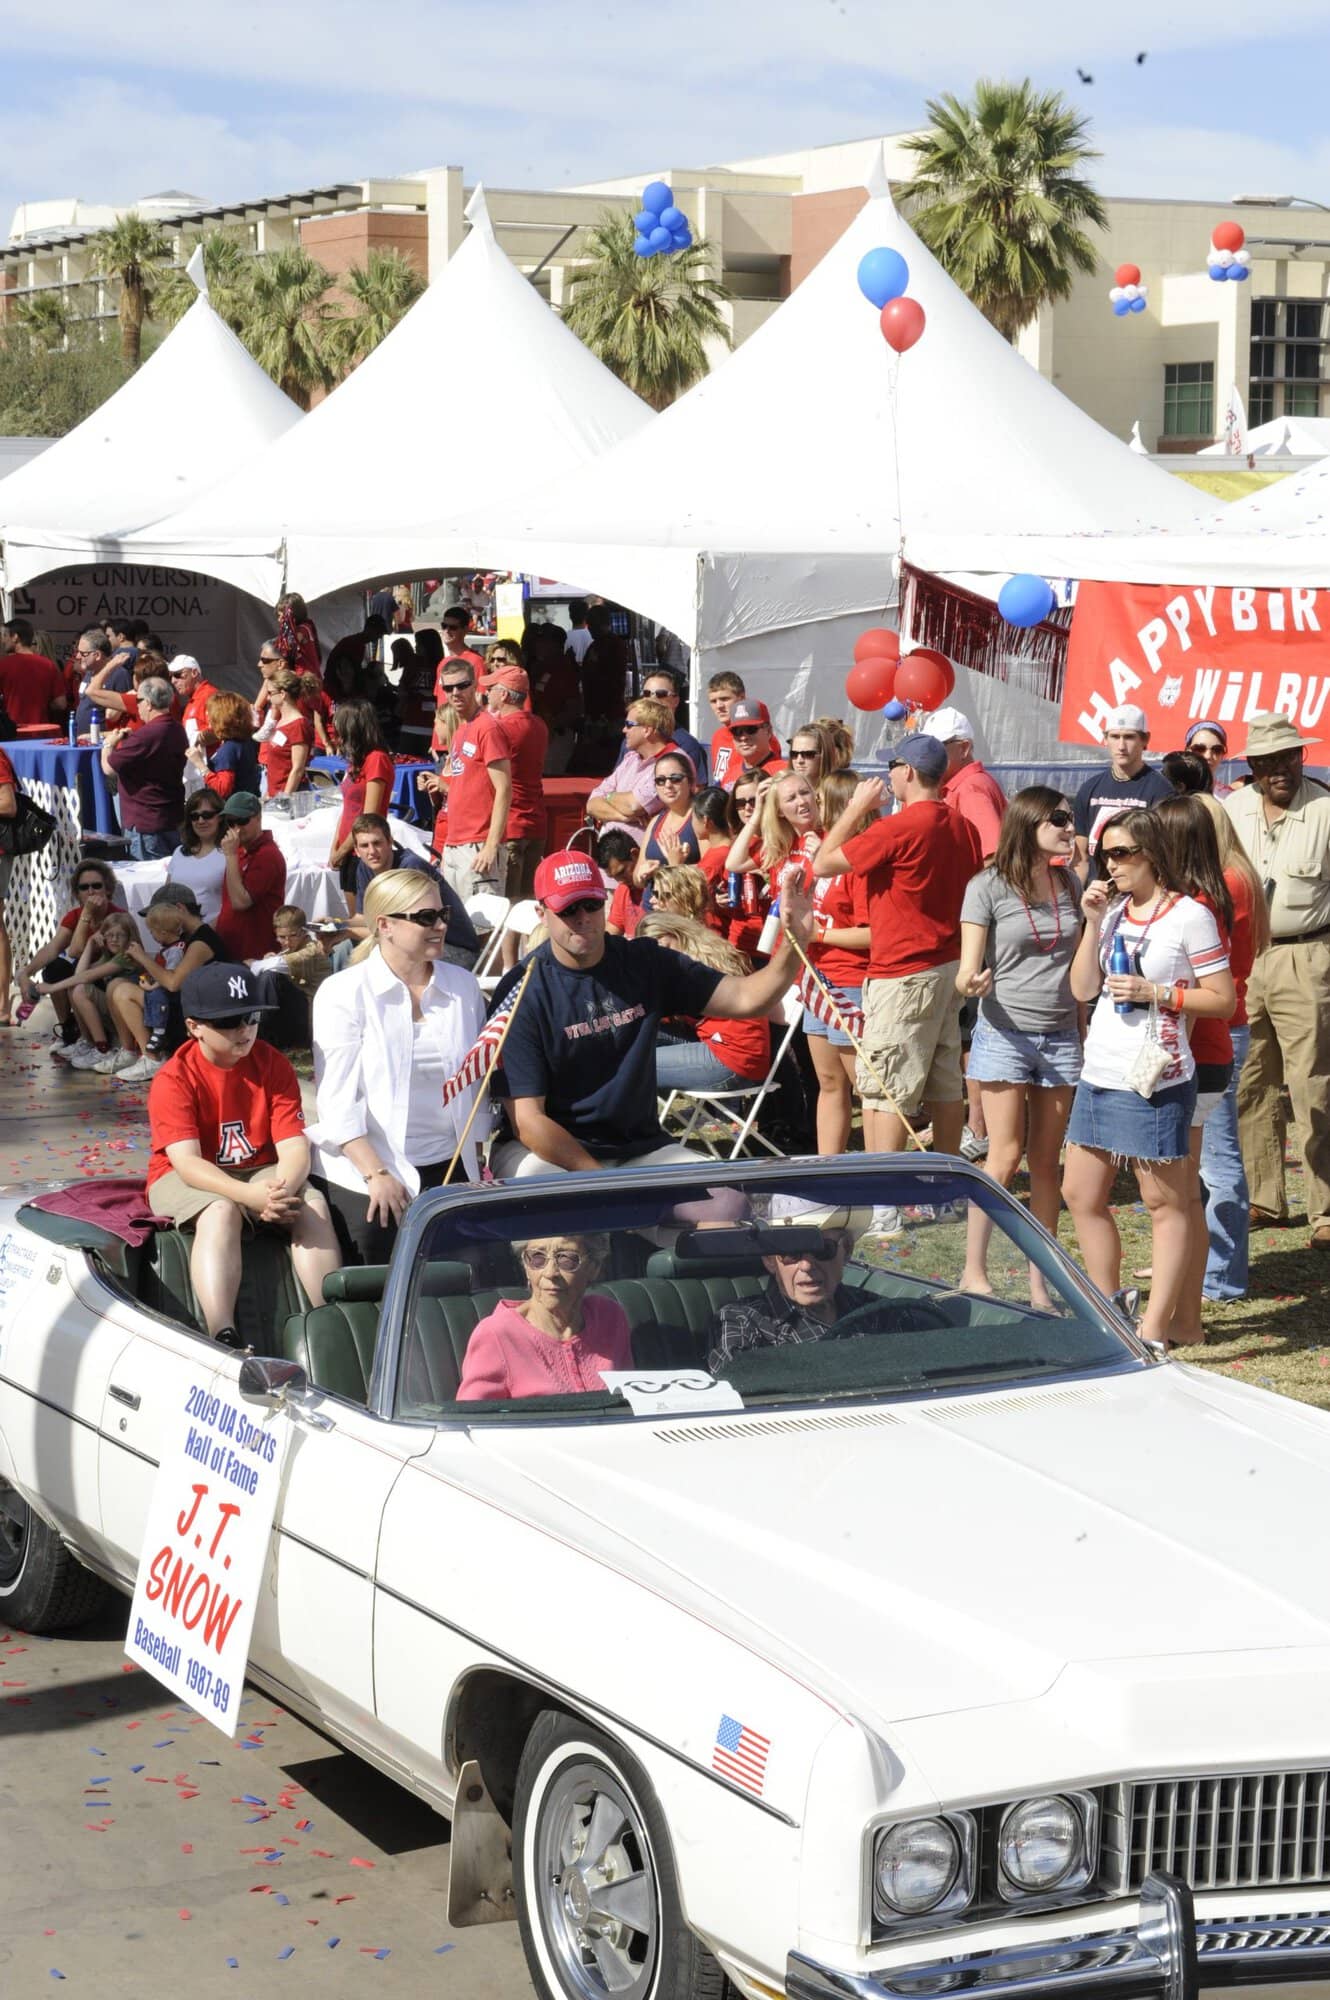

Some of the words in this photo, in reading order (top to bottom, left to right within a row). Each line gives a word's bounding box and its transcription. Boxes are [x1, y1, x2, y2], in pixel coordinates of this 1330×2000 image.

[56, 595, 88, 616] OF
[95, 592, 203, 617] ARIZONA
[1077, 586, 1217, 744] HAPPY
[554, 863, 593, 881] ARIZONA
[228, 976, 248, 999] NY
[216, 1120, 257, 1166] A
[185, 1386, 221, 1433] 2009
[219, 1407, 236, 1438] UA
[235, 1414, 277, 1464] Sports
[185, 1426, 208, 1465] Hall
[210, 1446, 225, 1473] of
[223, 1453, 259, 1496] Fame
[146, 1546, 243, 1656] SNOW
[134, 1617, 182, 1677] Baseball
[185, 1657, 231, 1714] 1987-89
